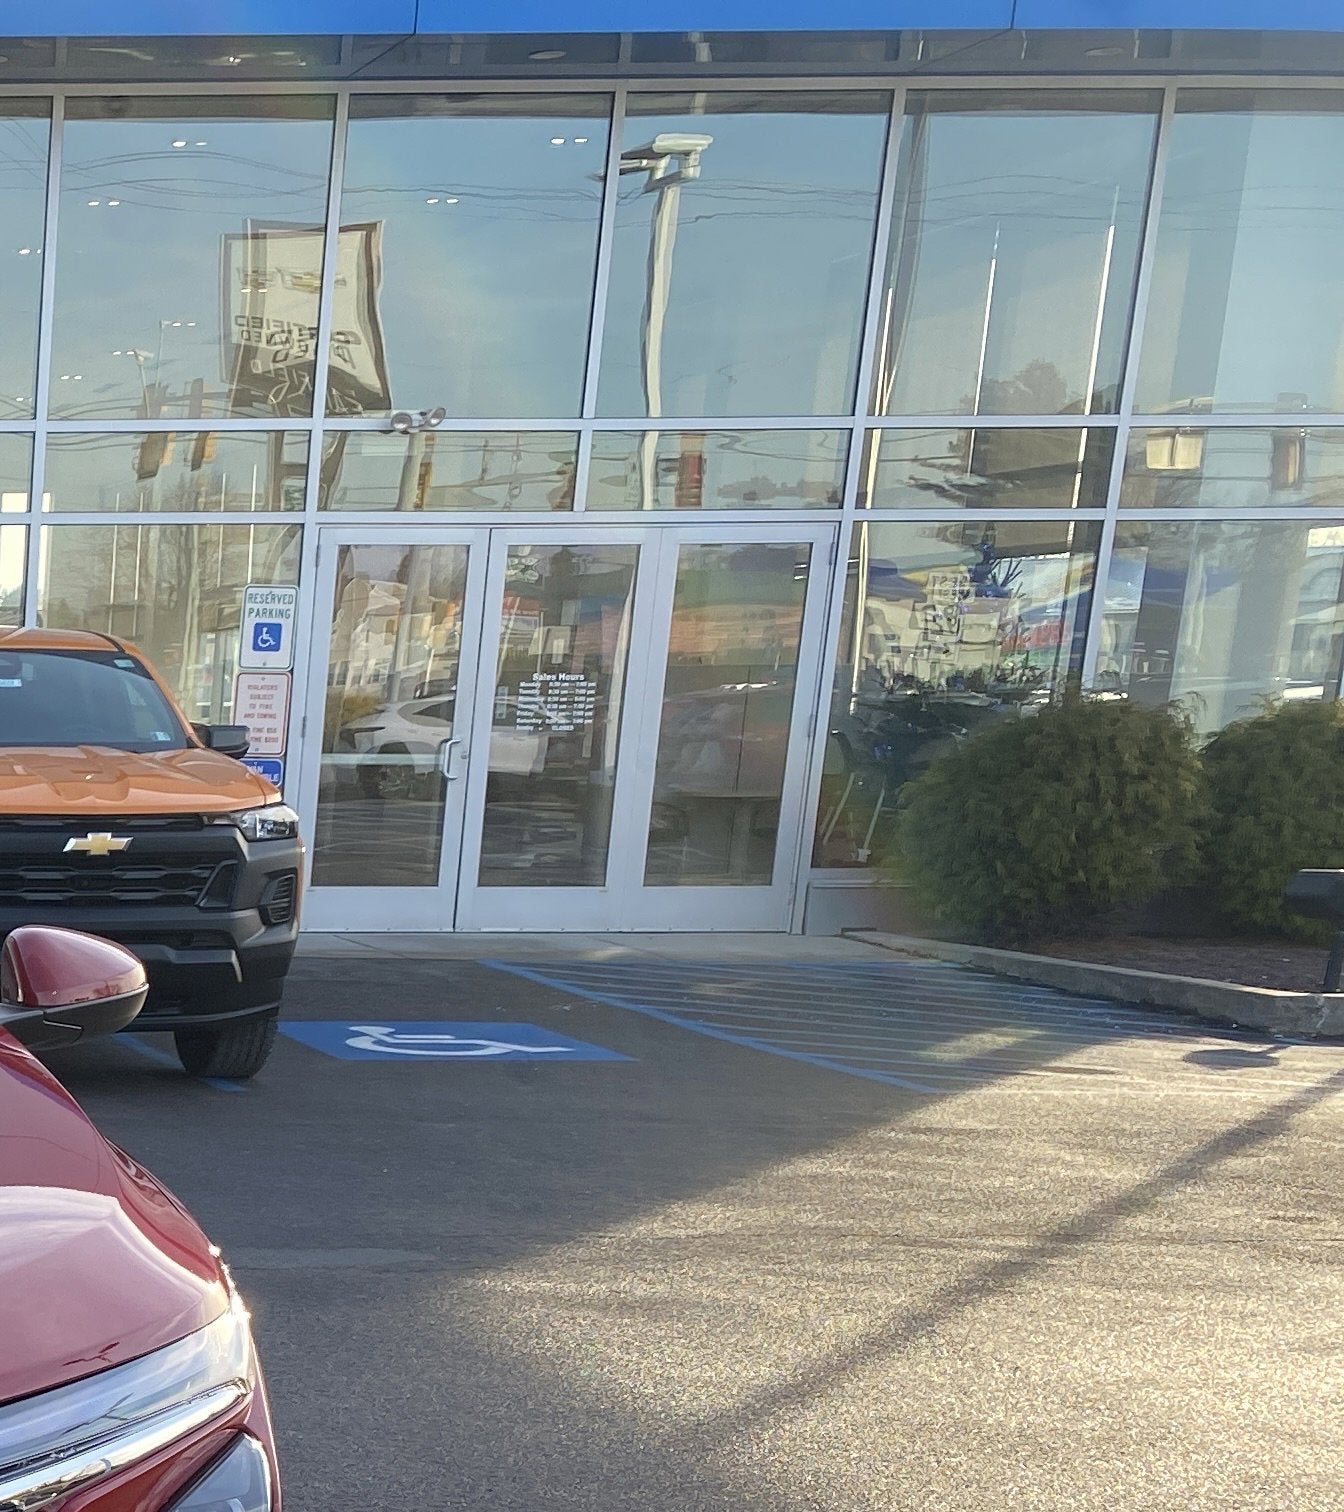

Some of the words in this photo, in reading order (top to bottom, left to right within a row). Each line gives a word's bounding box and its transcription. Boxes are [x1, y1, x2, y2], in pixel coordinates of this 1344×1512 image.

[247, 592, 294, 605] RESERVED
[247, 607, 291, 620] PARKING
[532, 672, 557, 681] Sales
[558, 672, 585, 681] Hours
